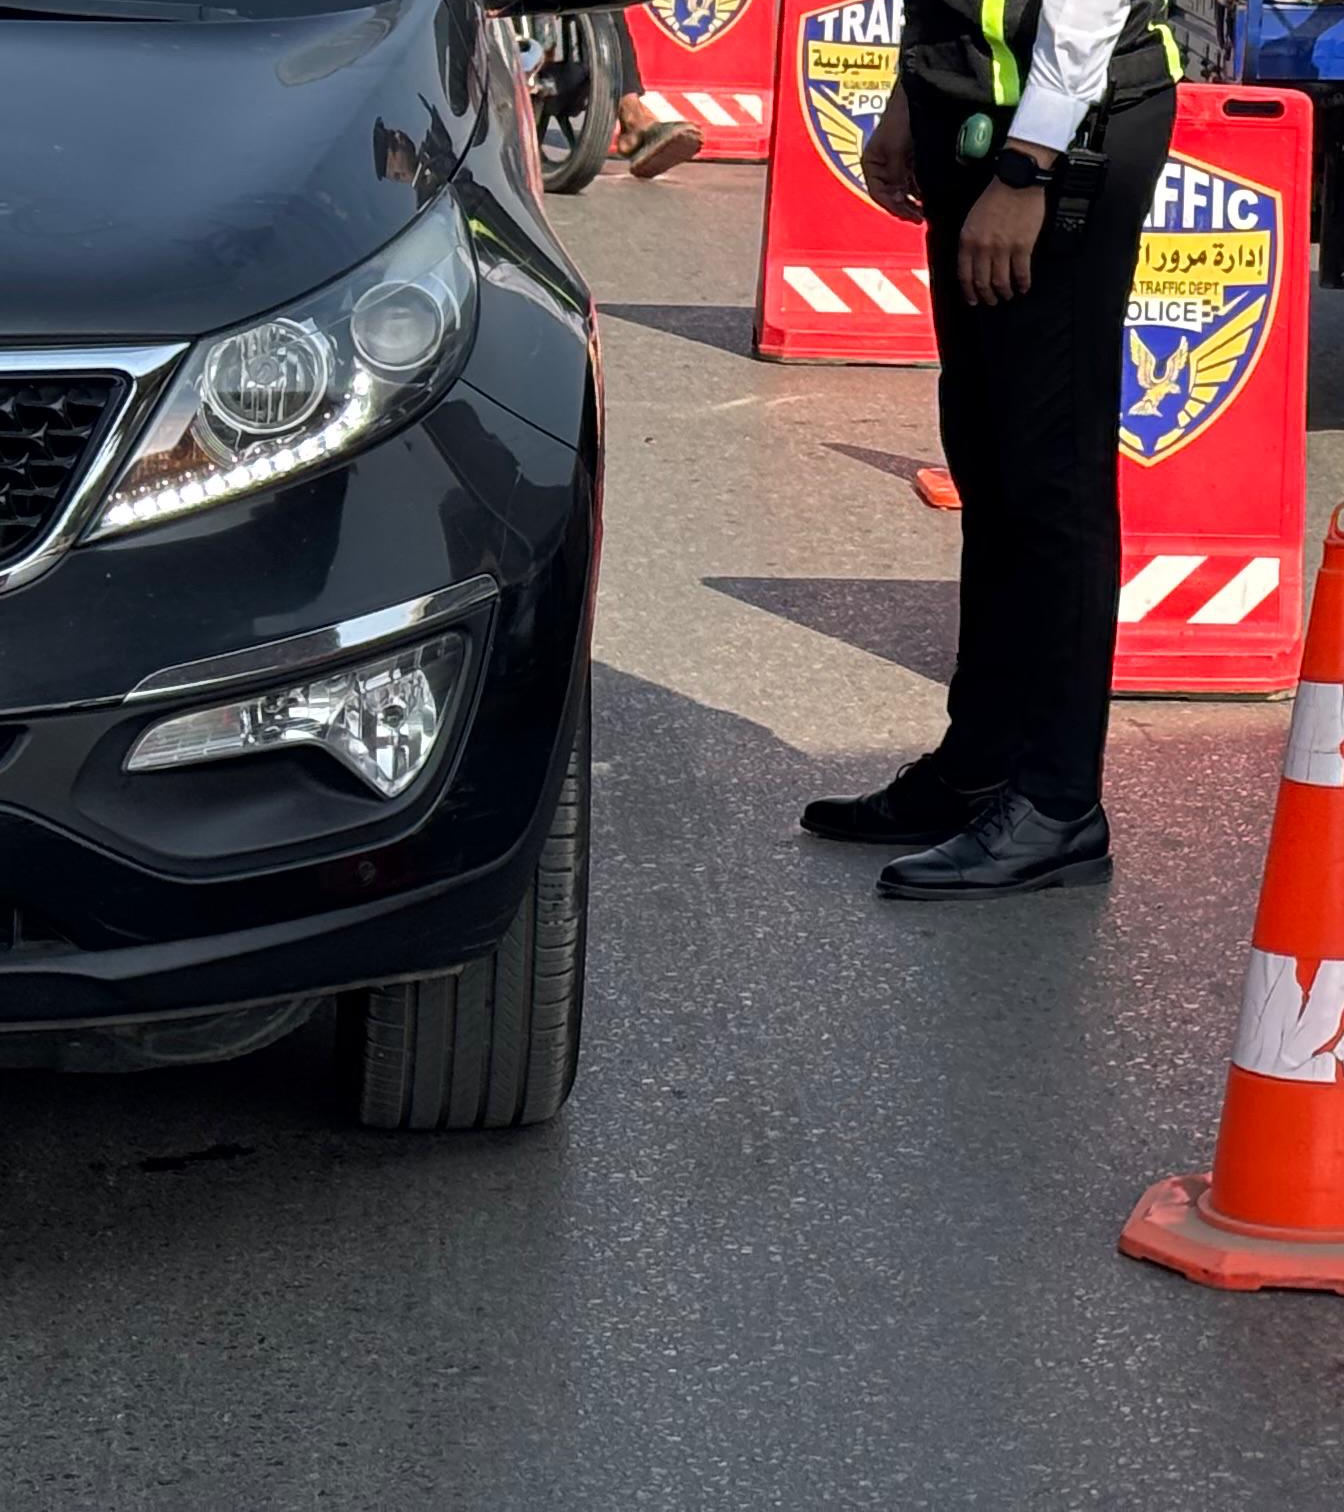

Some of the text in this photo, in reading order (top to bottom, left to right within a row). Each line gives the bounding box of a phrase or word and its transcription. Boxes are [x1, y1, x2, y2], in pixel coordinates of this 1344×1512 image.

[812, 49, 890, 76] القليوبية
[1143, 162, 1259, 230] FFIC
[1152, 249, 1208, 274] مرور
[1213, 243, 1264, 276] إدارة
[1139, 281, 1186, 296] TRAFFIC
[1126, 300, 1198, 323] OLICE
